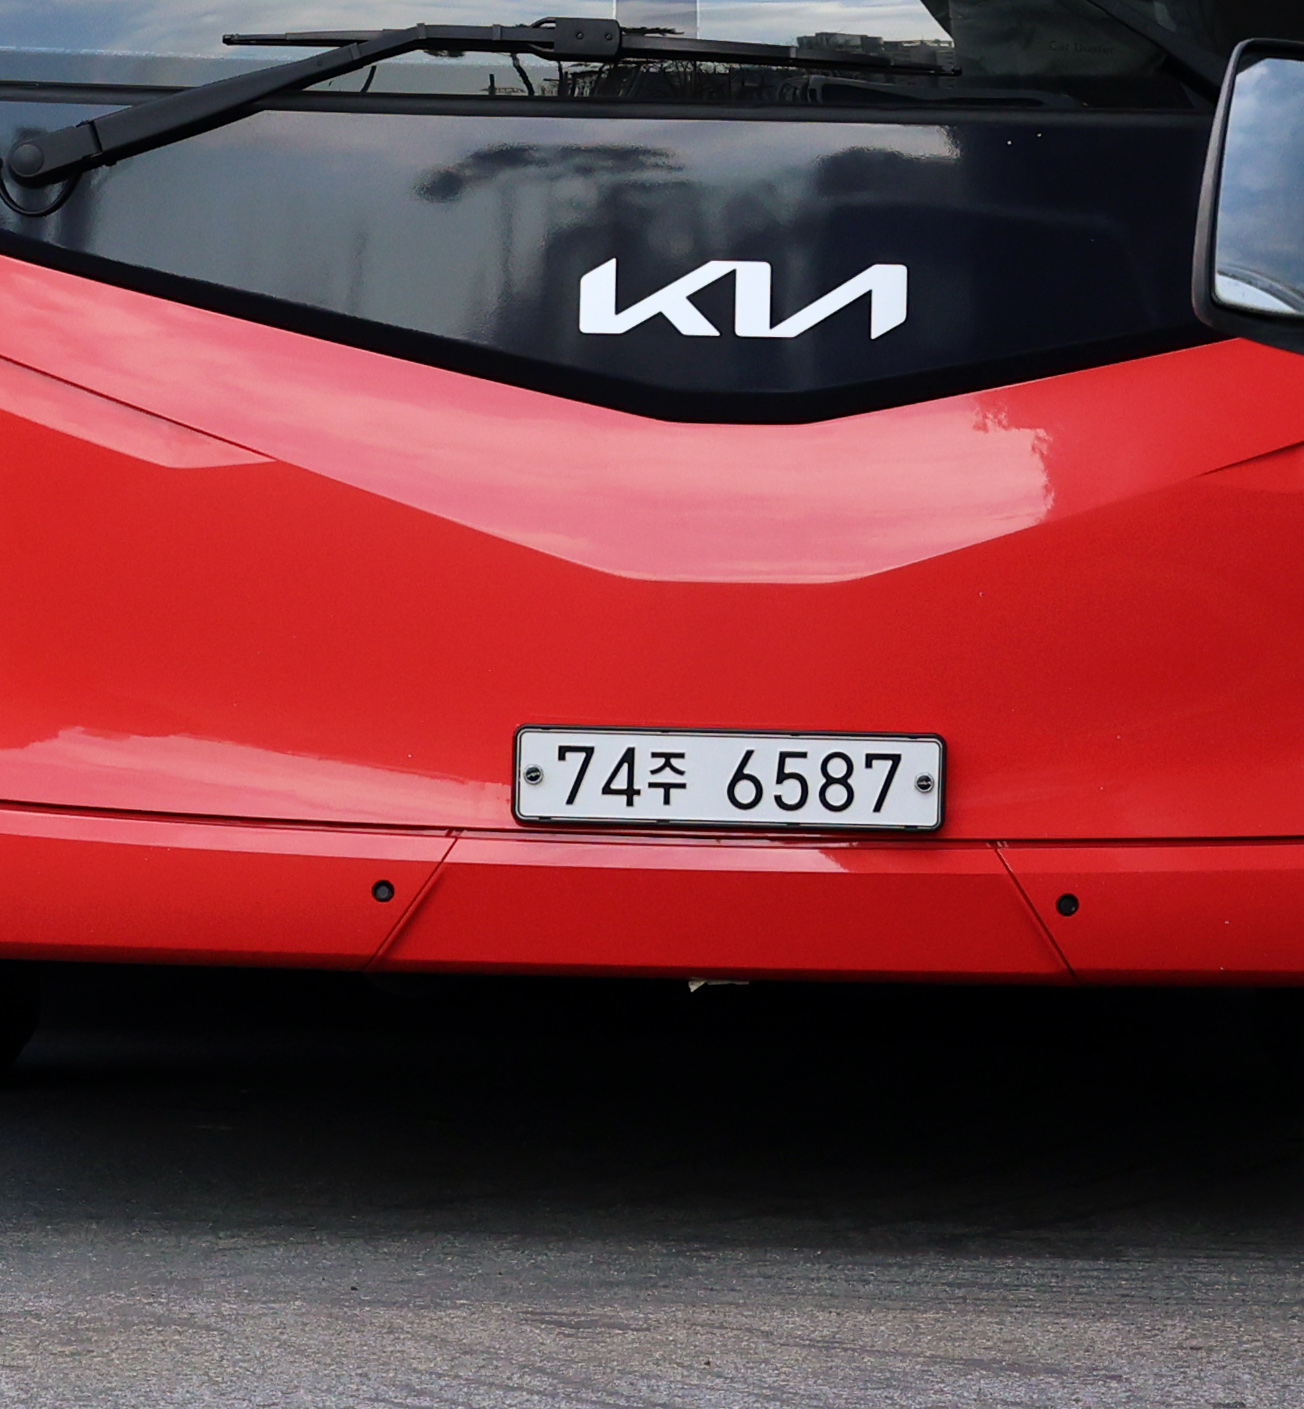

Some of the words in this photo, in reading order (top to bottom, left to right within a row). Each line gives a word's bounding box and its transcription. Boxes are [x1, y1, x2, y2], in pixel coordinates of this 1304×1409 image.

[578, 256, 909, 341] KIA
[556, 744, 688, 808] 74주
[726, 748, 903, 814] 6587
